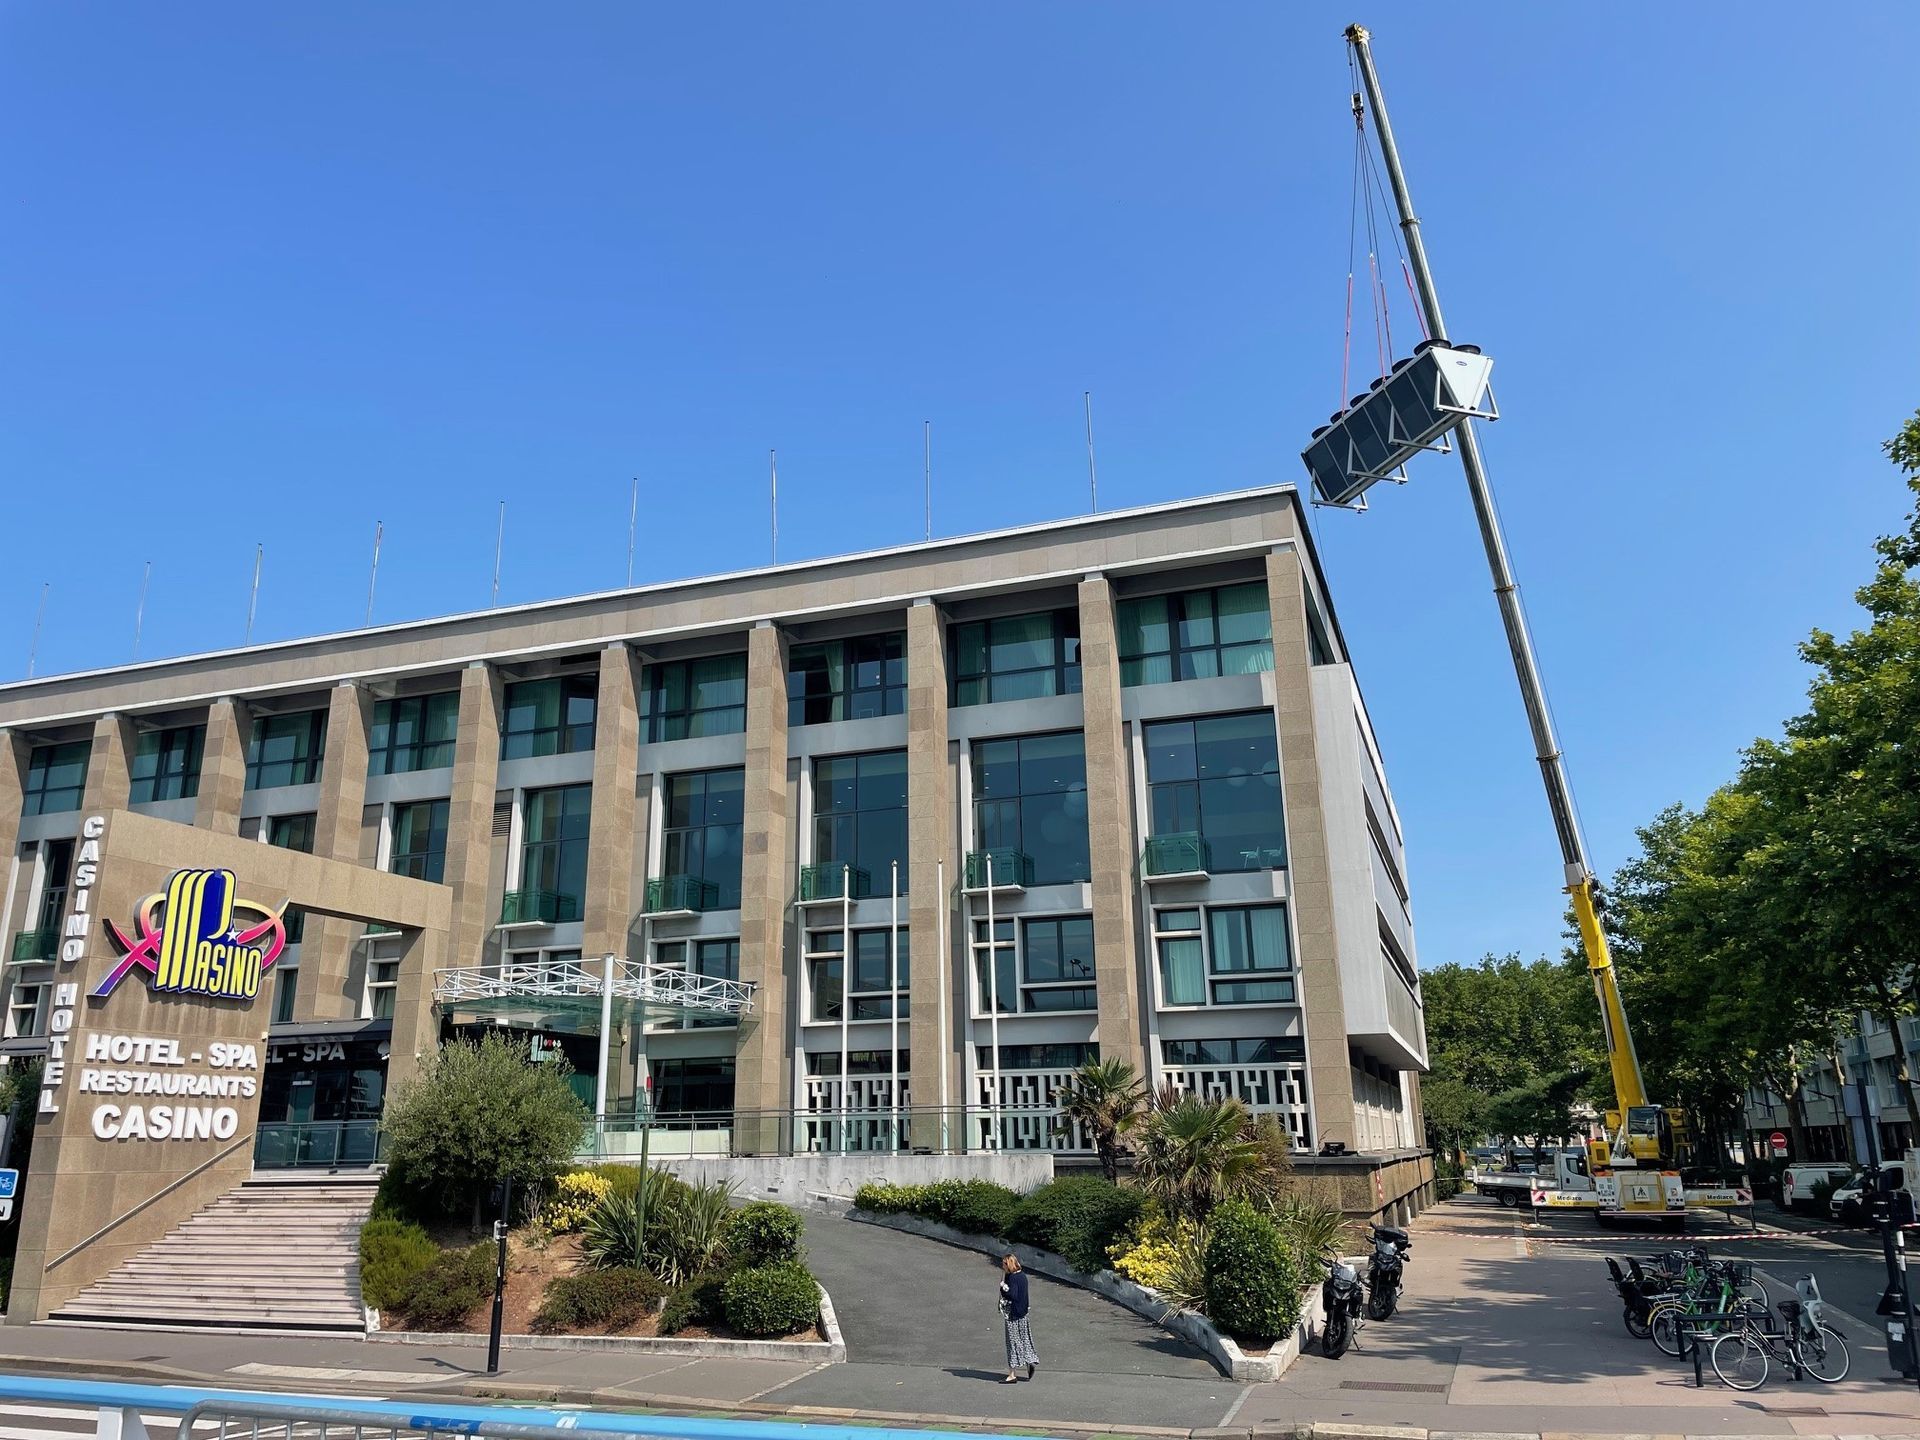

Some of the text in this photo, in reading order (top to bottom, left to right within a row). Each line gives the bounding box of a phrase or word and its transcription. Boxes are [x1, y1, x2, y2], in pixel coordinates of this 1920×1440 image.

[38, 816, 104, 1114] CASINO HOTEL
[86, 1034, 186, 1067] HOTEL
[208, 1042, 258, 1070] SPA
[302, 1043, 345, 1062] SPA
[80, 1068, 257, 1098] RESTAURANTS
[92, 1104, 239, 1140] CASINO
